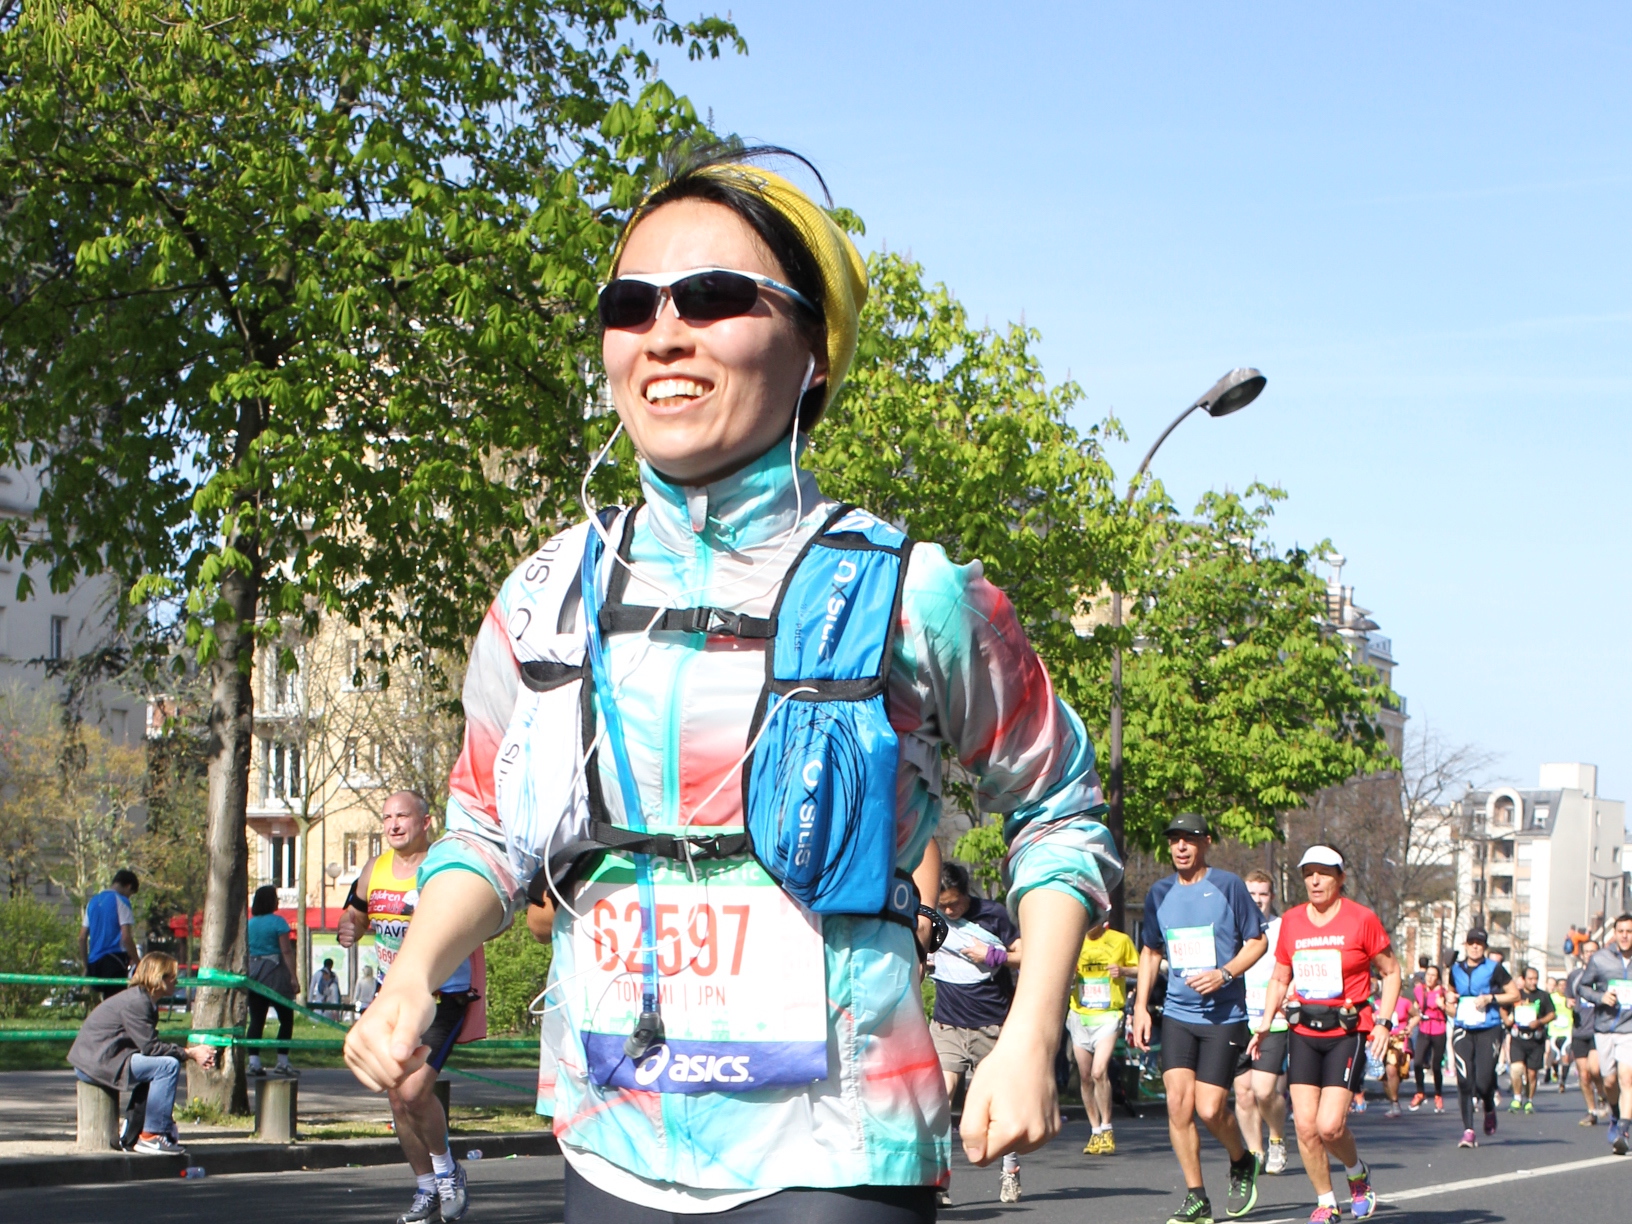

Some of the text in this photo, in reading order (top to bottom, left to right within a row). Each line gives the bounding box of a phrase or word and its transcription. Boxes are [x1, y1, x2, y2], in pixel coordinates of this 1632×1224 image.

[671, 858, 760, 881] Electric
[593, 898, 750, 977] 62597
[1295, 935, 1345, 949] DENMARK
[1298, 963, 1328, 977] 56136
[613, 980, 726, 1006] TOMMI JPN
[668, 1053, 751, 1083] asics
